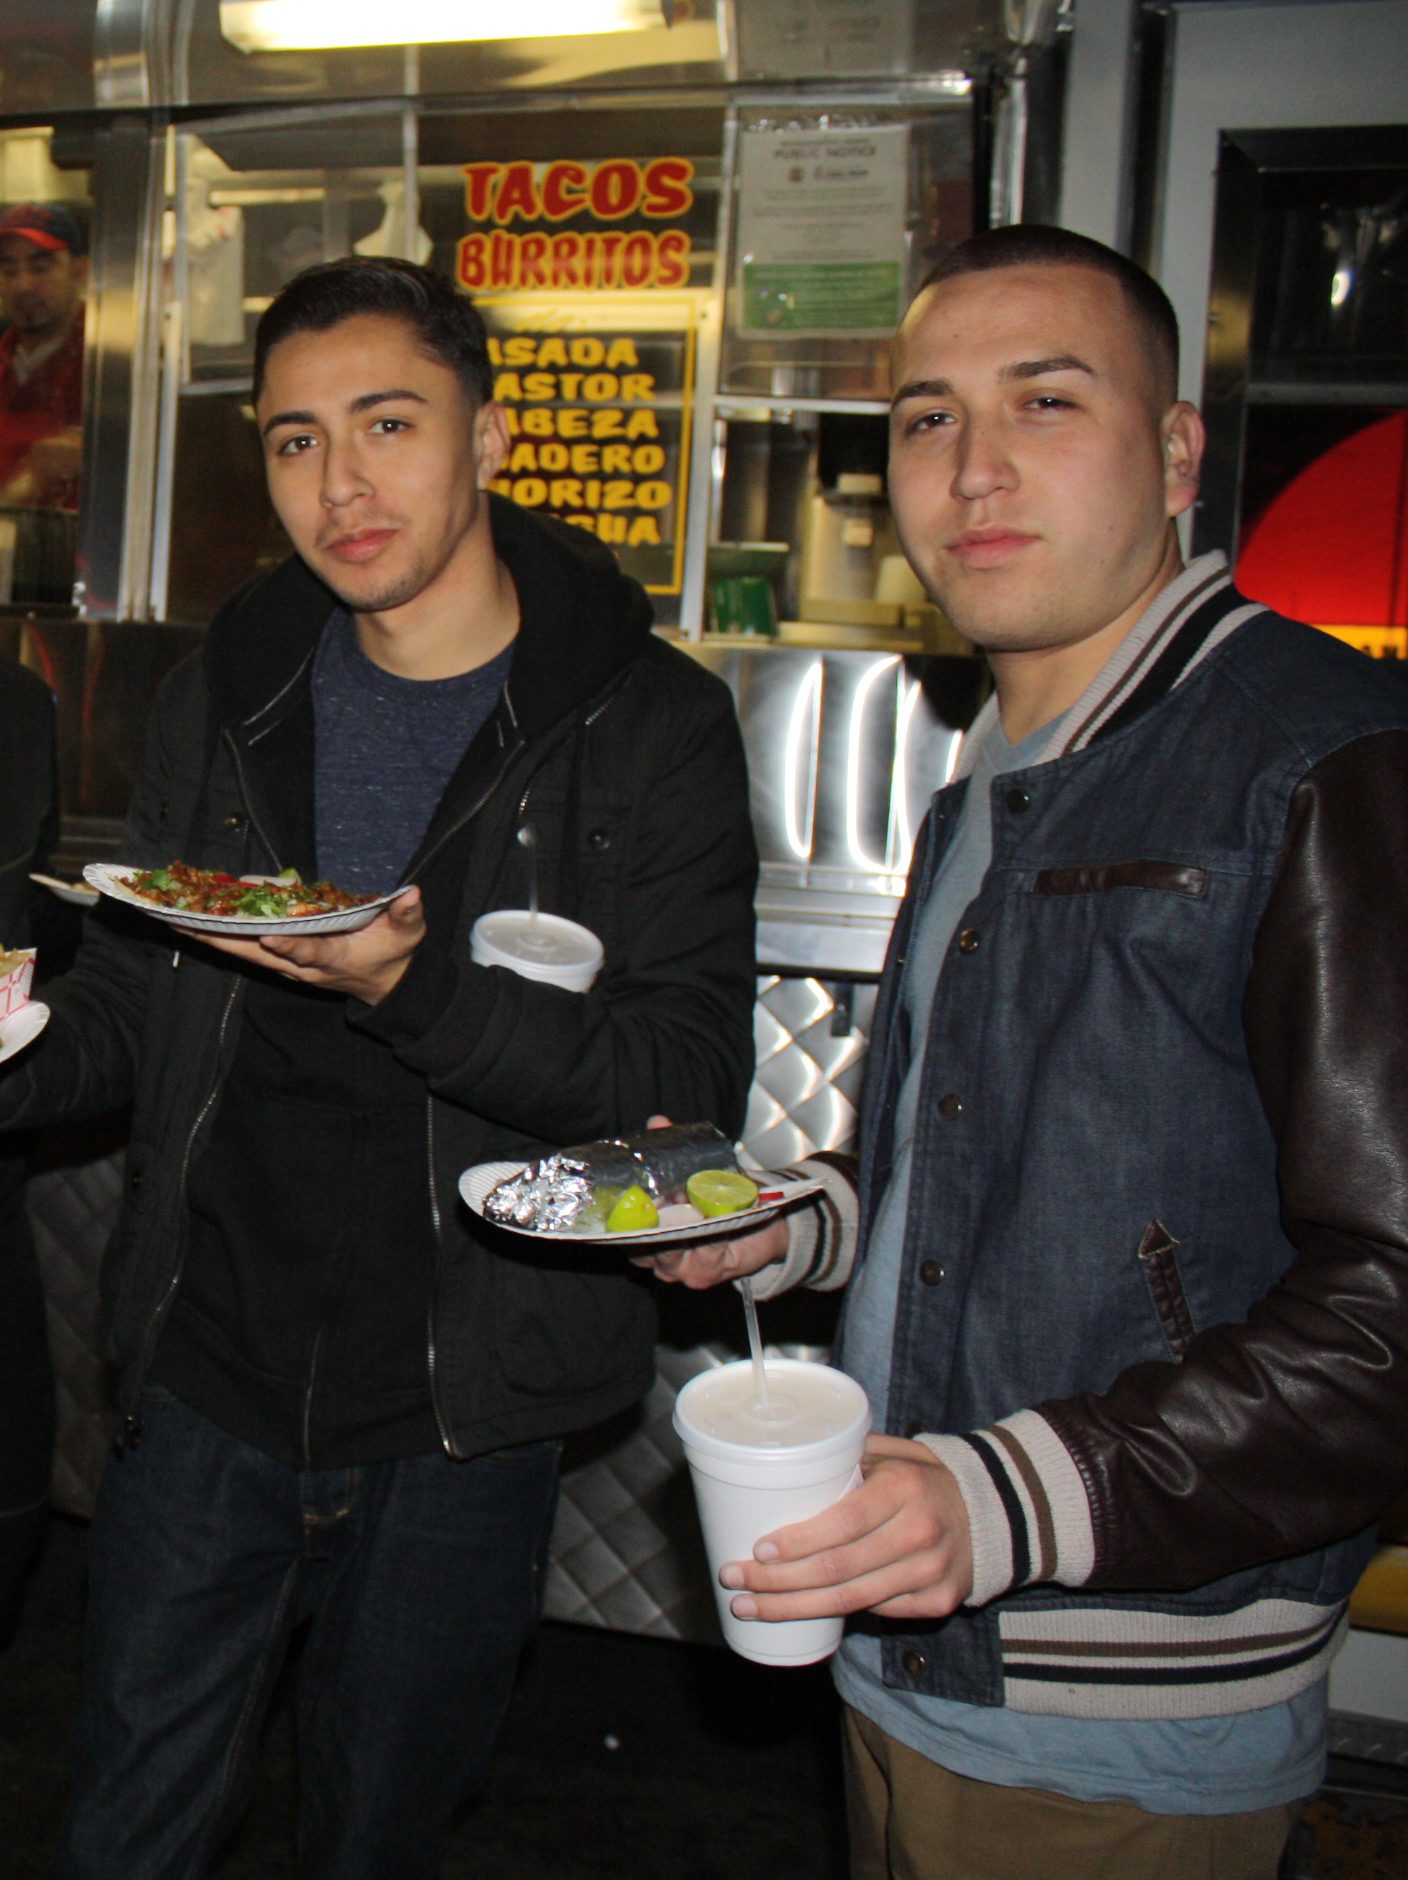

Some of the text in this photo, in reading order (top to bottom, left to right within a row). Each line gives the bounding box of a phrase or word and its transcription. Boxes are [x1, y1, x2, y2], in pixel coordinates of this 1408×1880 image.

[463, 157, 694, 225] TACOS
[456, 229, 691, 290] BURRITOS
[499, 442, 665, 474] ADERO
